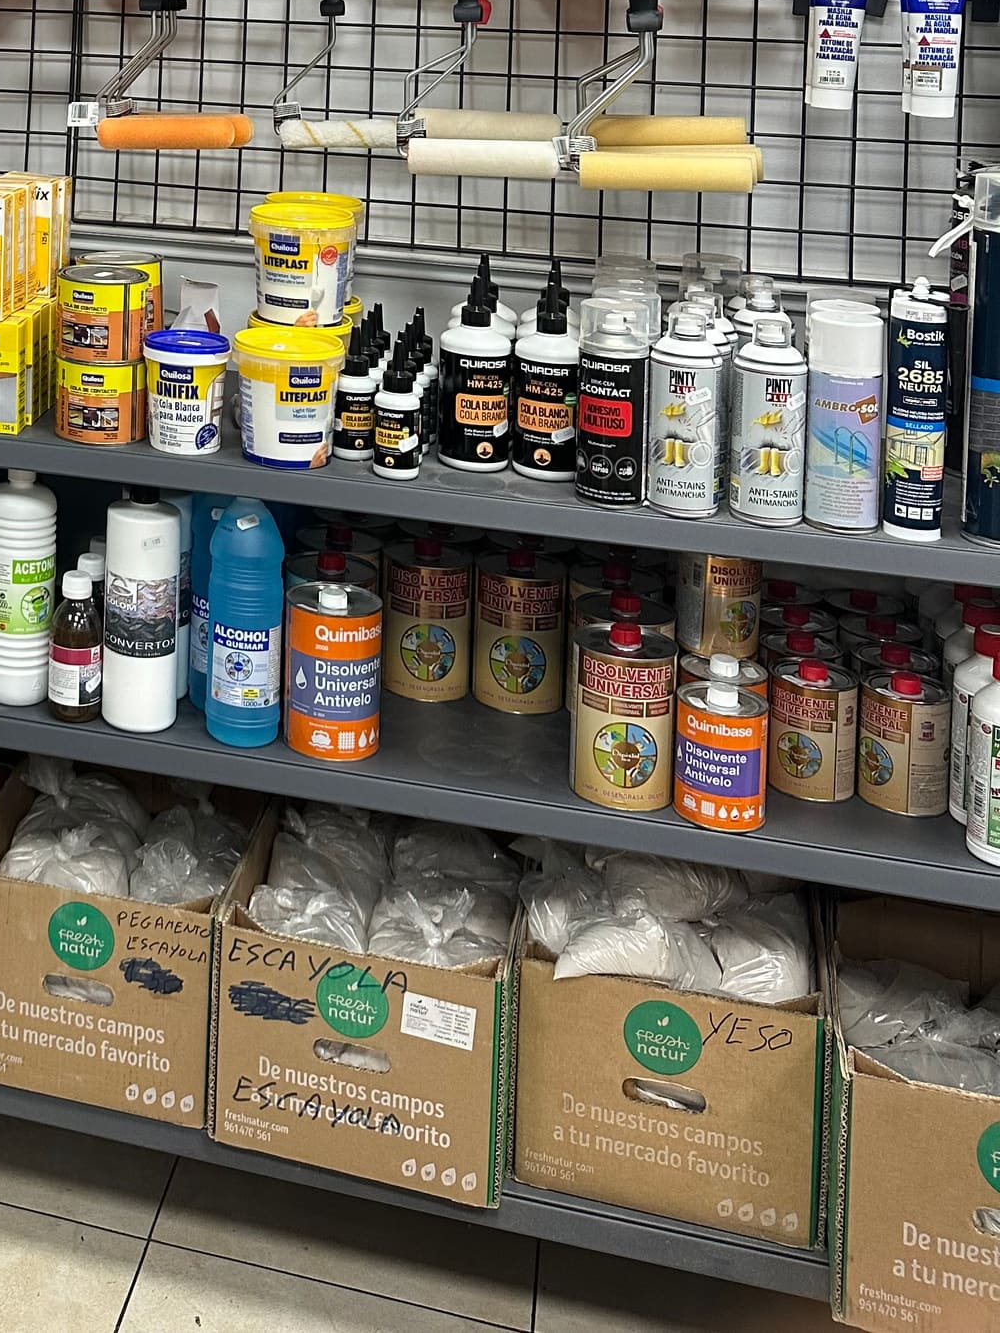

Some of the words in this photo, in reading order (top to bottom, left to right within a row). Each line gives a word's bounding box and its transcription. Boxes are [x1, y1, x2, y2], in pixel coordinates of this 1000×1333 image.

[827, 7, 853, 15] MASILLA
[828, 14, 835, 22] AL
[836, 14, 852, 22] AGUA
[818, 20, 833, 28] PARA
[833, 21, 859, 29] MADERA
[270, 242, 298, 254] Quilosa
[264, 255, 309, 270] LITEPLAST
[906, 329, 945, 342] Bostik
[914, 360, 932, 370] SIL
[81, 374, 104, 383] Quilosa
[160, 368, 192, 381] Quilosa
[291, 376, 321, 386] Quilosa
[669, 369, 696, 387] PINTY
[897, 367, 944, 384] 2685
[156, 381, 199, 400] UNIFIX
[467, 379, 503, 389] HM-425
[525, 384, 564, 397] HM-425
[580, 381, 632, 398] S-CONTACT
[669, 385, 696, 394] PLUS
[766, 377, 793, 395] PINTY
[898, 381, 943, 394] NEUTRA
[159, 399, 173, 410] Cola
[175, 399, 200, 412] Blanca
[280, 390, 328, 403] LITEPLAST
[460, 399, 481, 411] COLA
[482, 399, 507, 410] BLANCA
[766, 393, 793, 402] PLUS
[159, 411, 174, 420] para
[175, 410, 204, 423] Madera
[459, 410, 480, 421] COLA
[520, 402, 537, 416] COLA
[538, 405, 569, 418] BLANCA
[587, 402, 621, 418] ADHESIVO
[520, 413, 537, 426] COLA
[538, 417, 569, 429] BRANCA
[583, 413, 625, 431] MULTIUSO
[904, 422, 934, 431] SELLADO
[656, 476, 706, 491] ANTI-STAINS
[749, 486, 798, 499] ANTI-STAINS
[655, 487, 706, 499] ANTIMANCHAS
[748, 496, 798, 507] ANTIMANCHAS
[391, 568, 468, 589] DISOLVENTE
[393, 582, 466, 603] UNIVERSAL
[481, 576, 560, 601] DISOLVENTE
[106, 596, 138, 612] COLOM
[485, 593, 555, 615] UNIVERSAL
[214, 623, 269, 642] ALCOHOL
[225, 640, 264, 651] QUEMAR
[315, 657, 381, 677] Disolvente
[583, 655, 672, 683] DISOLVENTE
[315, 674, 378, 693] Universal
[586, 674, 668, 698] UNIVERSAL
[313, 692, 372, 708] Antivelo
[687, 714, 753, 738] Quimibase
[685, 740, 747, 764] Disolvente
[685, 754, 740, 776] Universal
[684, 765, 732, 788] Antivelo
[117, 910, 212, 939] PEGAMENTO
[59, 941, 103, 959] natur
[126, 935, 208, 963] ESCAYOLA
[227, 937, 409, 994] ESCAYOLA
[19, 999, 94, 1029] nuestros
[98, 1016, 166, 1045] campos
[327, 1006, 376, 1026] natur
[702, 1011, 793, 1052] YESO
[0, 1019, 19, 1040] tu
[23, 1027, 97, 1058] mercado
[100, 1040, 171, 1073] favorito
[636, 1043, 688, 1062] natur
[258, 1055, 281, 1080] De
[285, 1064, 367, 1101] nuestros
[371, 1085, 445, 1120] campos
[232, 1076, 401, 1136] ESCAYOLA
[224, 1108, 289, 1135] freshnatur.com
[562, 1091, 585, 1117] De
[591, 1105, 678, 1139] nuestros
[684, 1124, 763, 1157] campos
[553, 1125, 564, 1141] a
[569, 1126, 590, 1147] tu
[595, 1135, 682, 1168] mercado
[688, 1149, 770, 1188] favorito
[902, 1221, 931, 1251] De
[893, 1257, 905, 1278] a
[911, 1259, 936, 1286] tu
[859, 1283, 942, 1317] freshnatur.com
